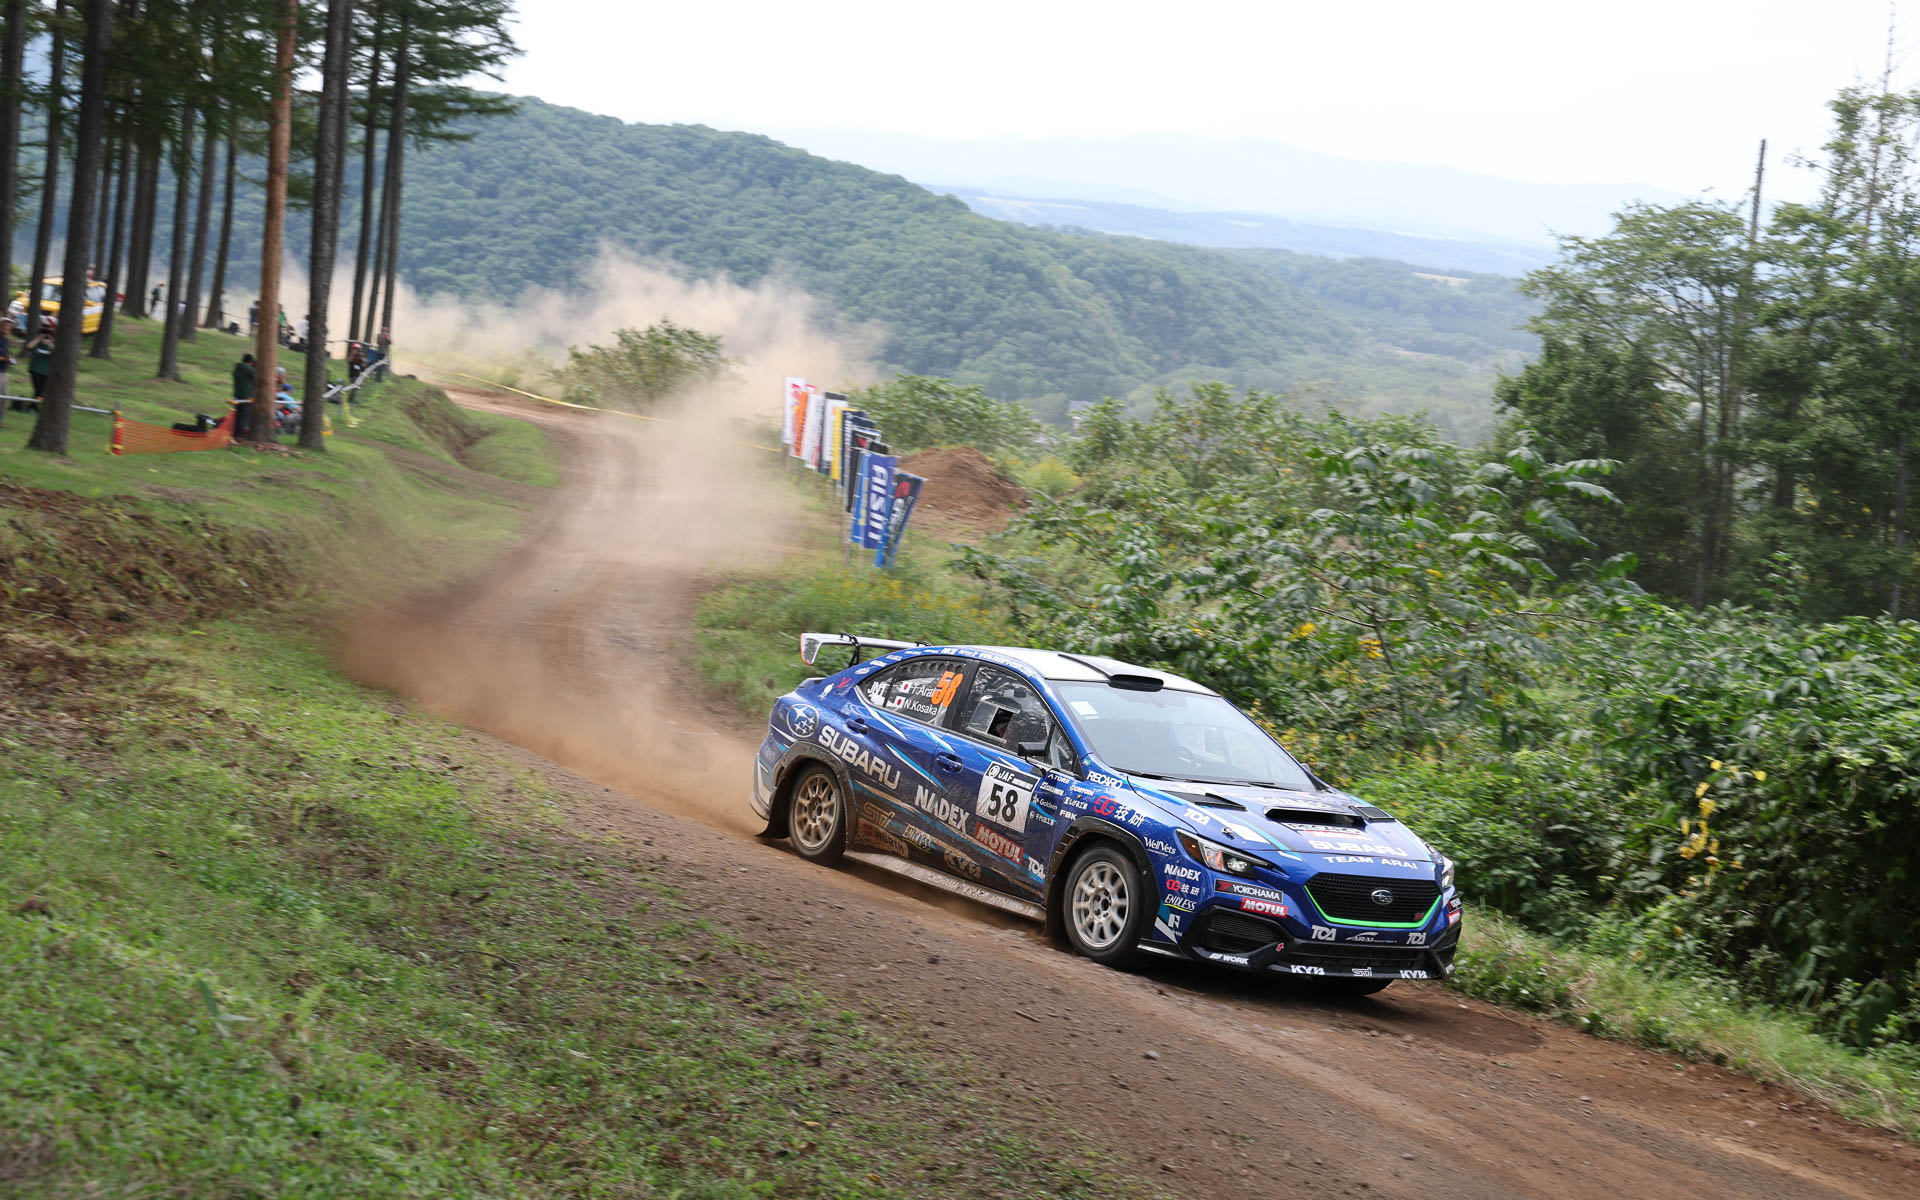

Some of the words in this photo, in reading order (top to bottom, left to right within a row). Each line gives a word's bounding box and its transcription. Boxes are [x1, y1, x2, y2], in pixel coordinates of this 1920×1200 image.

[932, 671, 963, 707] 58
[904, 698, 937, 716] N.Kosaka
[818, 725, 901, 790] SUBARU
[998, 770, 1015, 782] JAF
[1087, 770, 1124, 790] RECARO
[915, 785, 970, 833] NADEX
[987, 783, 1019, 823] 58
[1040, 798, 1058, 811] Goldwin
[1059, 809, 1078, 821] FBK
[975, 825, 1021, 864] MOTUL
[1308, 839, 1409, 857] SUBARU
[1164, 863, 1202, 881] NADEX
[1323, 856, 1375, 864] TEAM
[1381, 857, 1418, 870] ARAI
[1232, 884, 1281, 901] YOKOHAMA
[1164, 893, 1197, 911] ENDLESS
[1243, 899, 1286, 917] MOTUL
[1223, 954, 1250, 965] WORK
[1290, 964, 1326, 976] KYB
[1400, 969, 1428, 979] KYB
